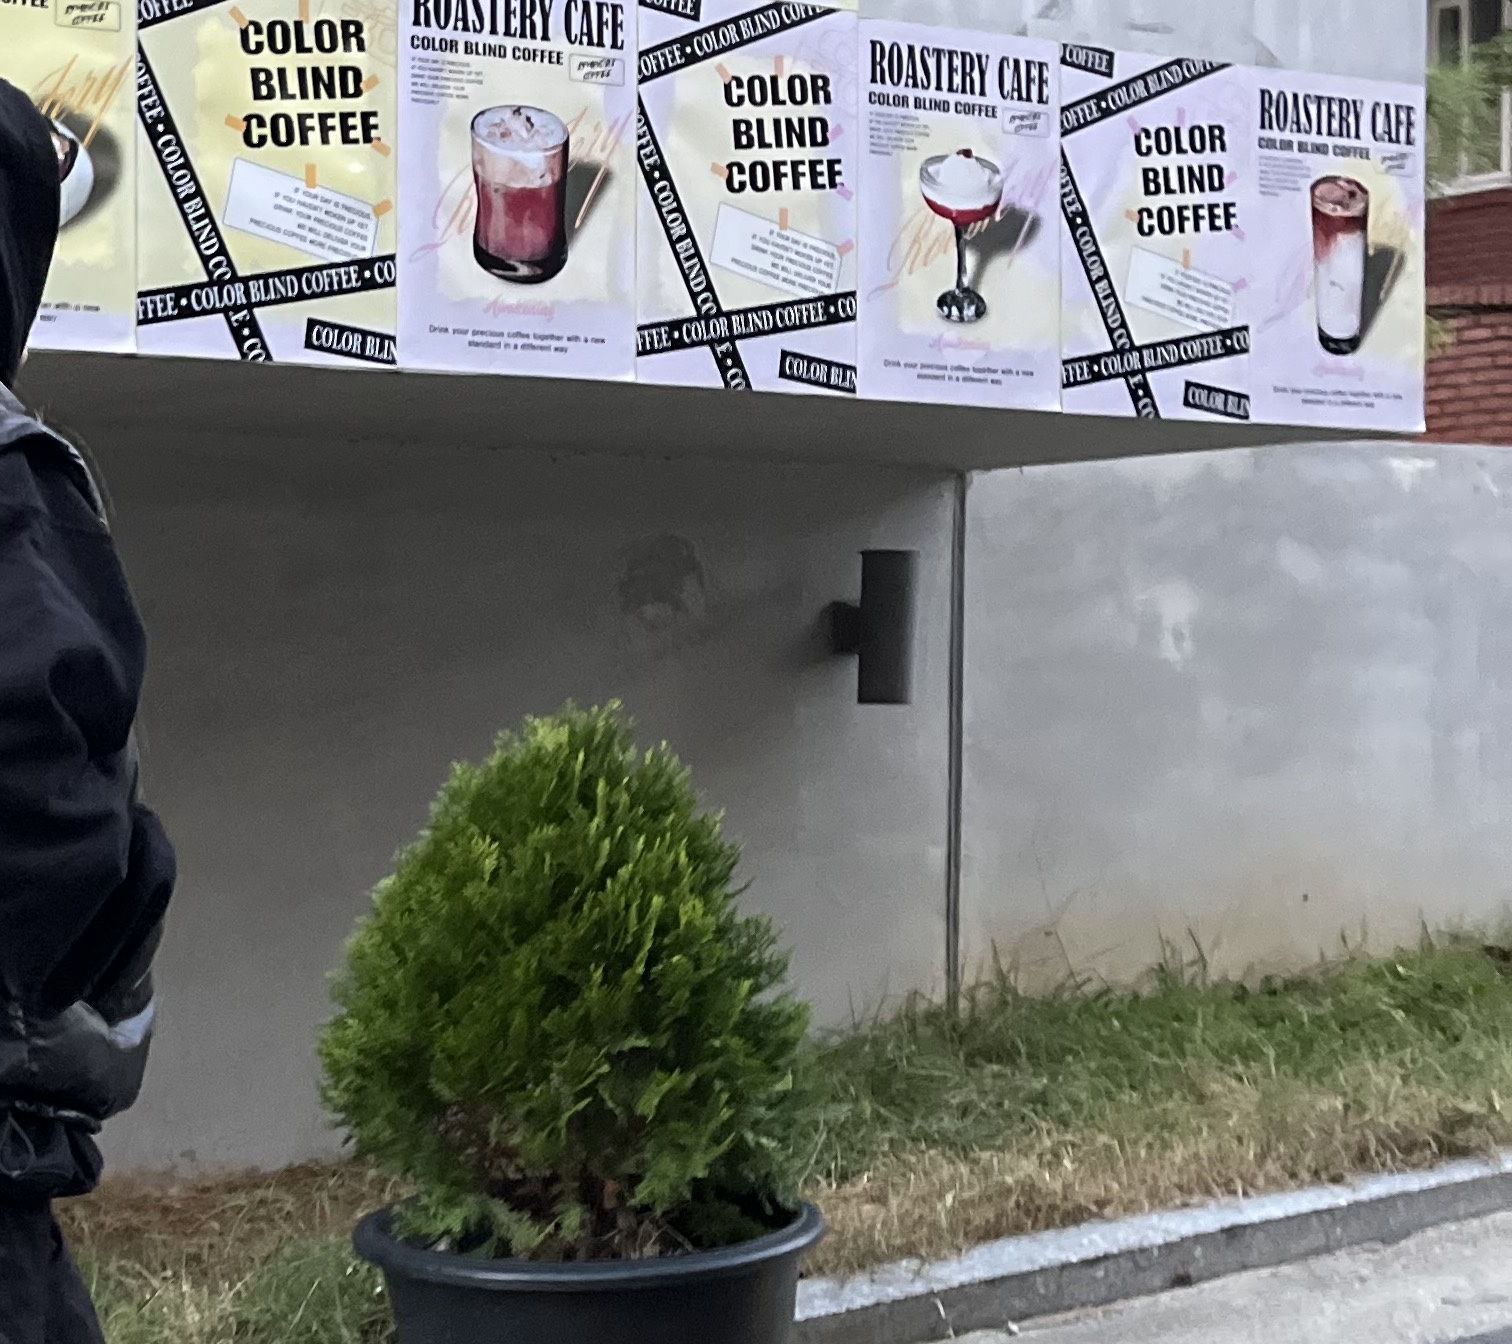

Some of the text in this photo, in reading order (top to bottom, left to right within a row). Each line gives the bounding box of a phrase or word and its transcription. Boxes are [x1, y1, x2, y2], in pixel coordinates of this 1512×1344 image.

[239, 19, 365, 55] COLOR
[410, 34, 563, 65] COLOR BLIND COFFEE
[692, 8, 781, 56] COLOR BLIND
[249, 65, 363, 101] BLIND
[869, 38, 1049, 105] ROASTERY CAFE
[723, 73, 831, 108] COLOR
[868, 90, 997, 119] COLOR BLIND COFFEE
[242, 110, 380, 149] COFFEE
[732, 116, 829, 150] BLIND
[1258, 87, 1415, 146] ROASTERY CAFE
[1133, 124, 1227, 157] COLOR
[725, 158, 843, 194] COFFEE
[1141, 163, 1225, 196] BLIND
[157, 134, 220, 255] COLOR BLIND
[1136, 201, 1238, 237] COFFEE
[191, 264, 362, 311] COLOR BLIND COFFEE
[311, 324, 363, 354] COLOR
[681, 300, 827, 343] COLOR BLIND COFFEE
